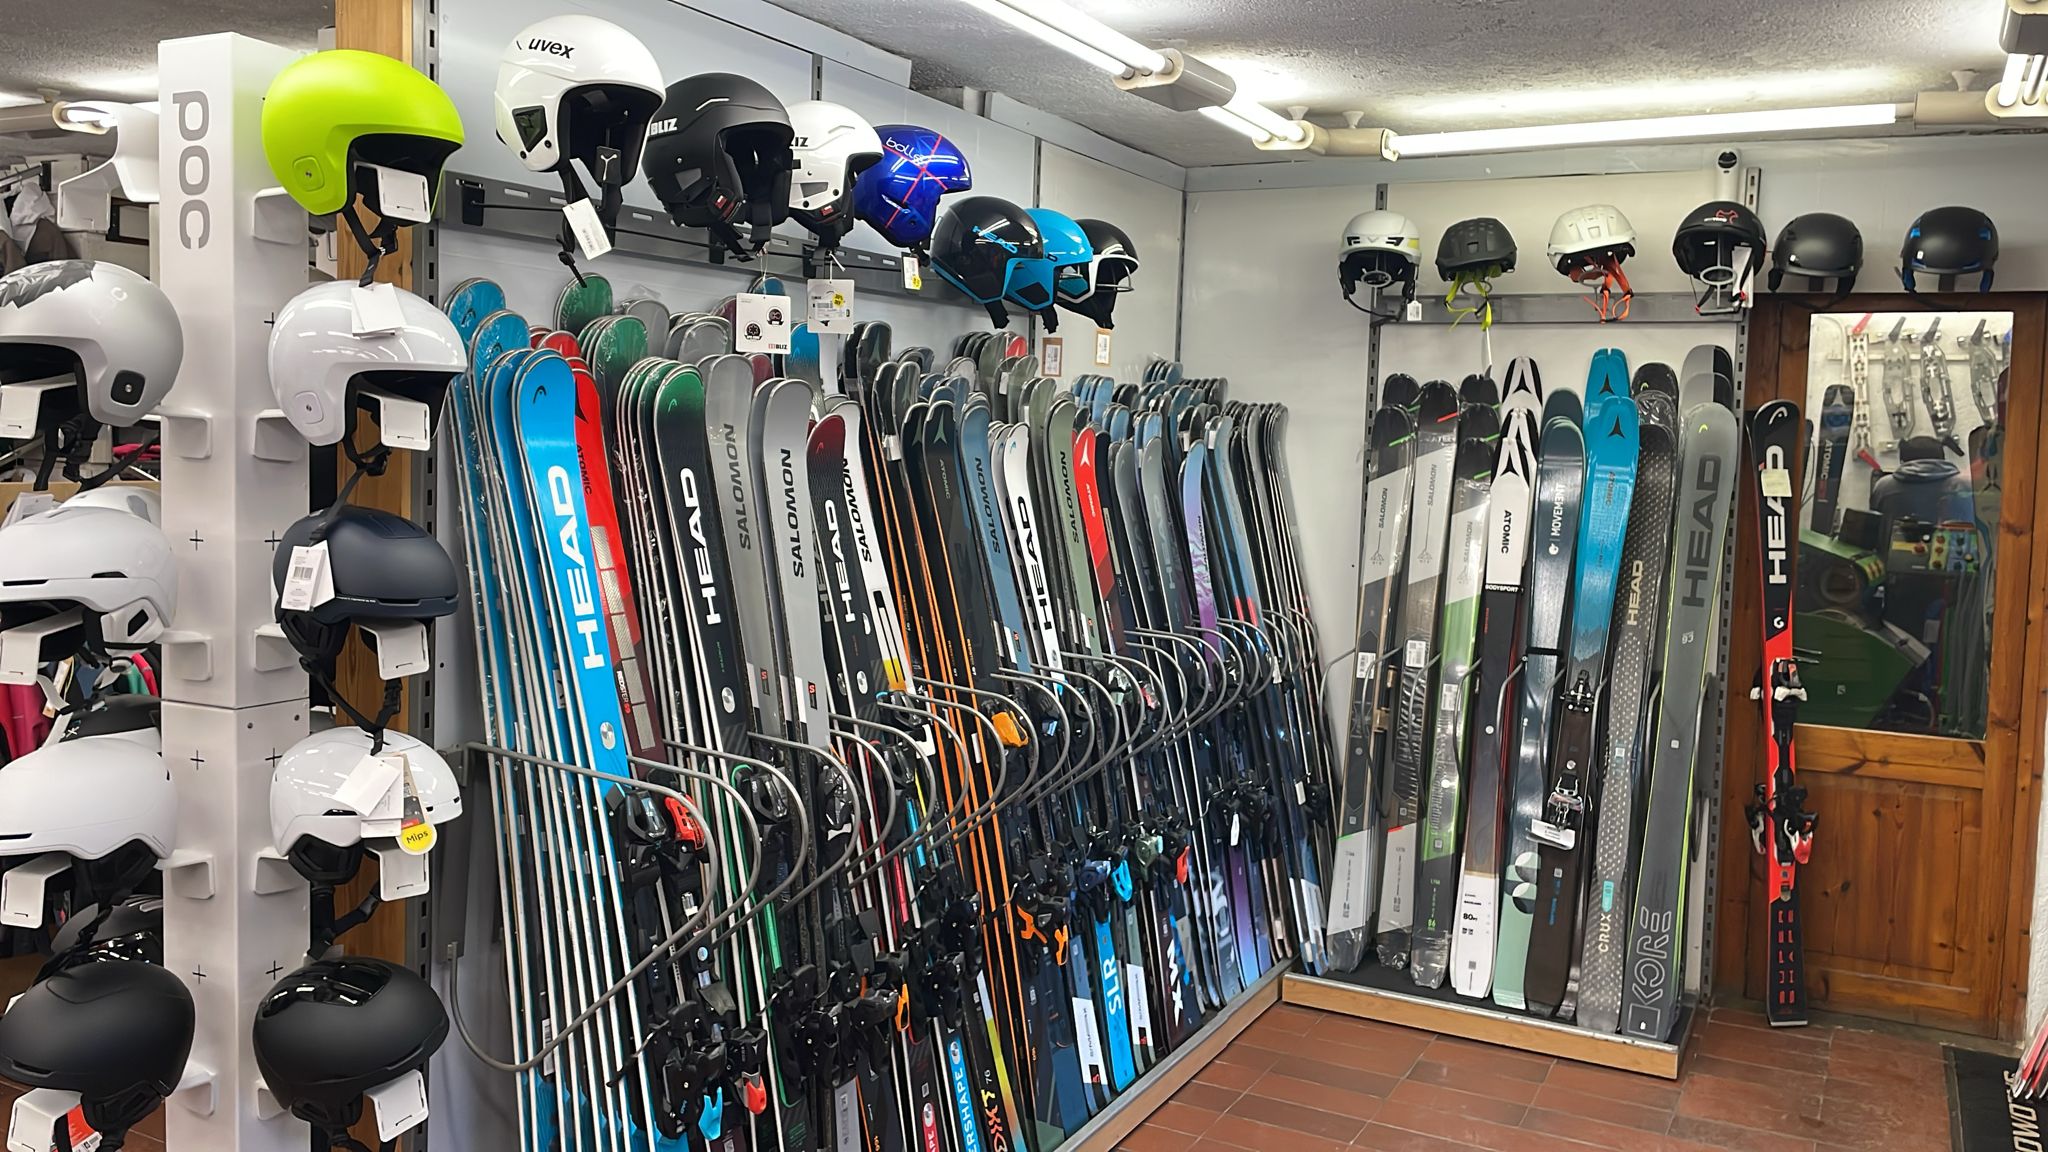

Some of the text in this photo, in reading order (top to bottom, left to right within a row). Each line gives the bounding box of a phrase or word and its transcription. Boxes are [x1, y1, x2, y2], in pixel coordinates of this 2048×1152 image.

[528, 38, 575, 59] uvex
[723, 423, 751, 550] SALOMON
[939, 458, 951, 500] ATOMIC
[1427, 463, 1437, 506] SALOMON
[1820, 439, 1834, 480] ATOMIC
[780, 448, 805, 578] SALOMON
[843, 457, 872, 563] SALOMON
[975, 457, 1001, 554] SALOMON
[1060, 451, 1079, 544] SALOMON
[1378, 487, 1388, 528] SALOMON
[1551, 483, 1566, 537] MOVEMENT
[680, 467, 721, 625] HEAD
[824, 499, 856, 623] HEAD
[1501, 509, 1512, 554] ATOMIC
[1681, 453, 1722, 608] HEAD
[547, 465, 605, 670] HEAD
[1018, 496, 1052, 630] HEAD
[1485, 584, 1519, 593] BODYSPORT
[1627, 559, 1643, 626] HEAD
[616, 670, 629, 703] REDSTER
[406, 831, 429, 844] Mips
[1598, 912, 1612, 953] CRUX
[1103, 954, 1122, 1016] SLR
